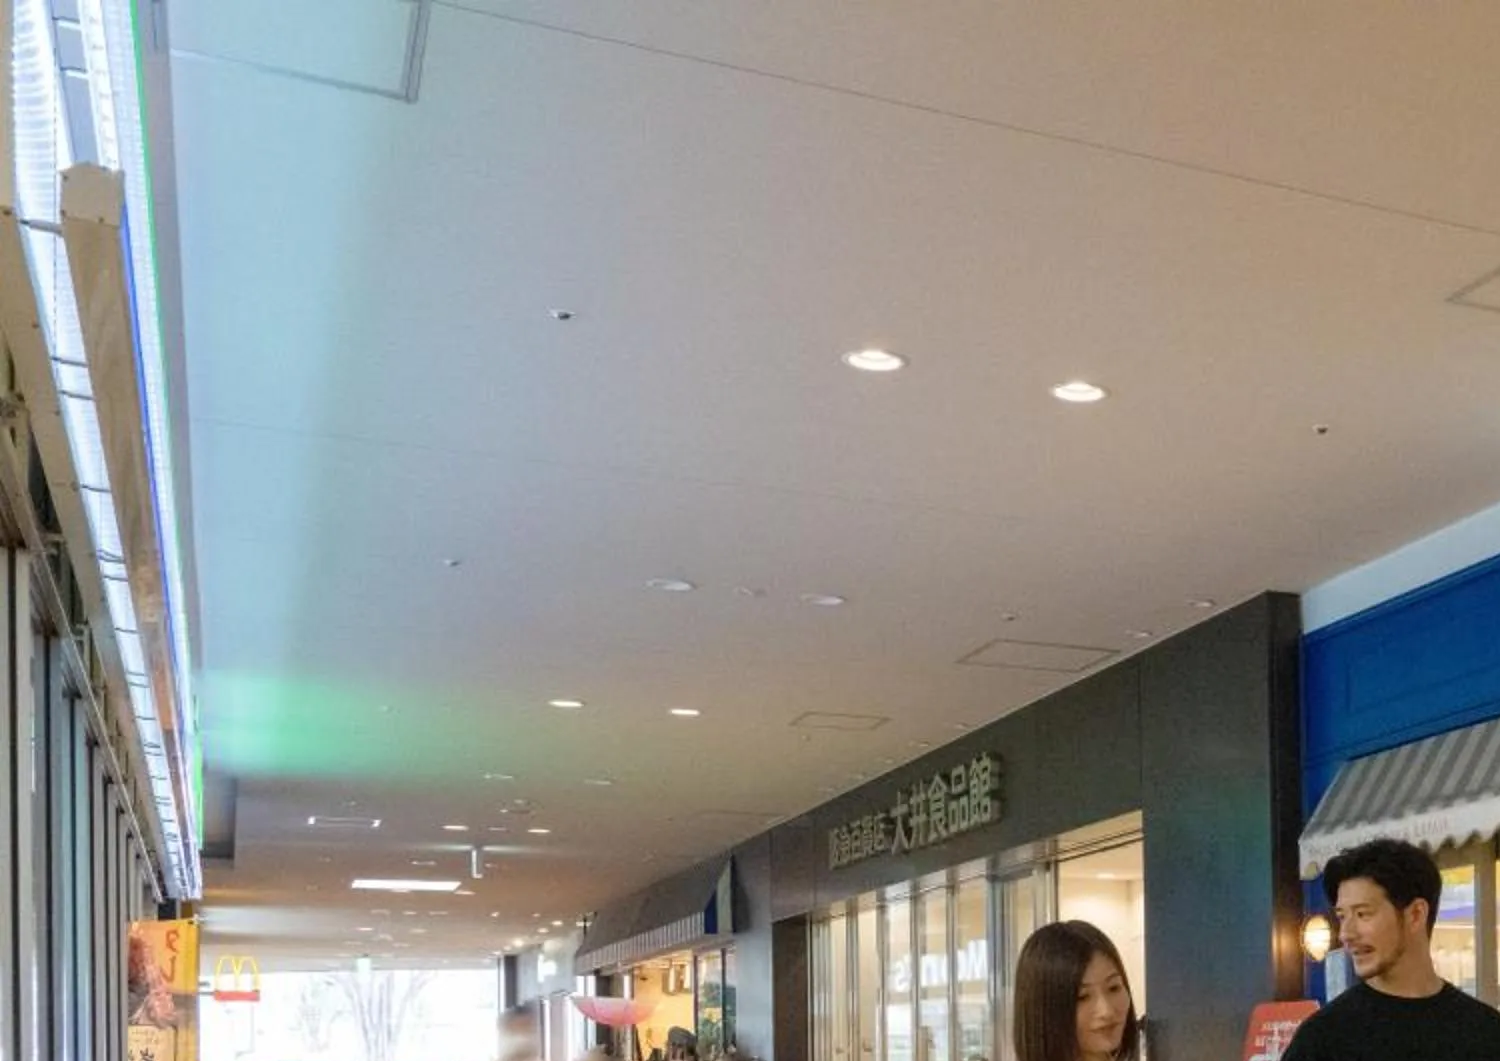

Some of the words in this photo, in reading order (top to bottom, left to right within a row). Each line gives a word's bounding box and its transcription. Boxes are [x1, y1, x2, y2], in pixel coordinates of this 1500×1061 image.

[890, 751, 998, 855] 大井食品館
